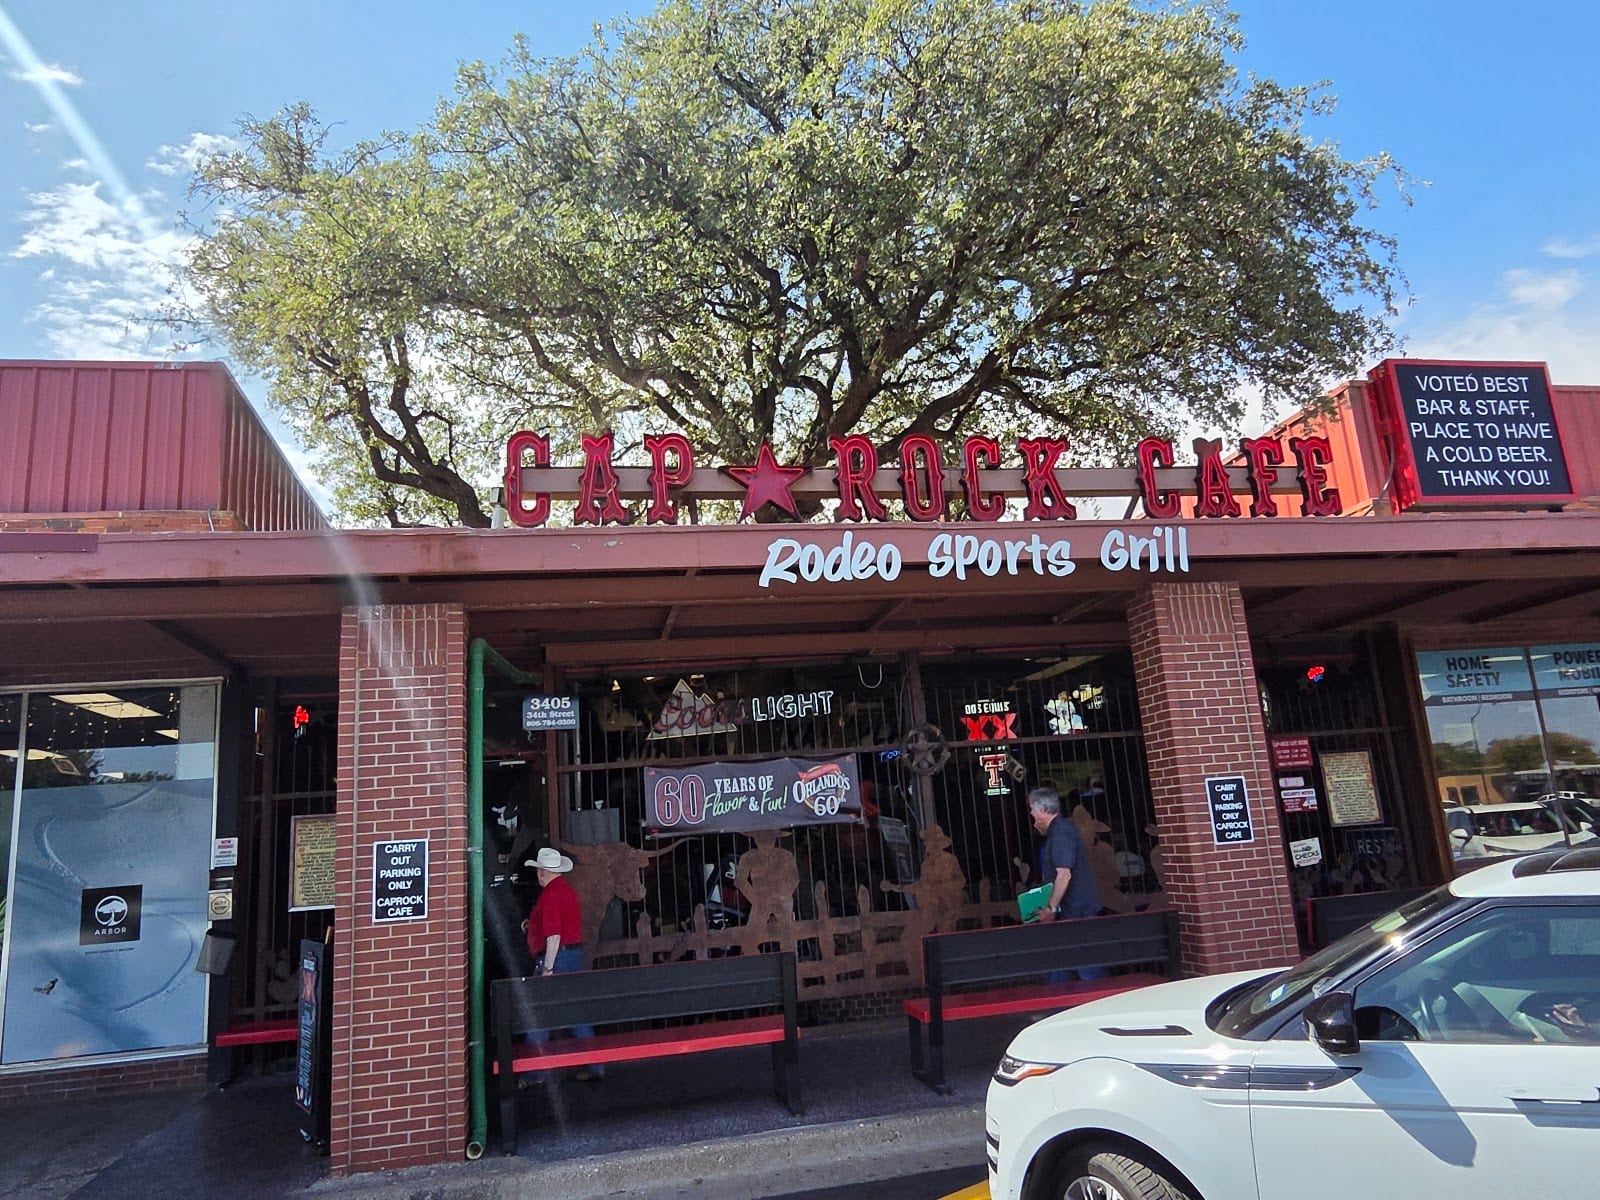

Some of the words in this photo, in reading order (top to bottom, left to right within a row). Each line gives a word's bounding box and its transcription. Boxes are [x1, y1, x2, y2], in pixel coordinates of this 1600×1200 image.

[1415, 373, 1479, 392] VOTED
[1483, 376, 1529, 392] BEST
[1416, 399, 1454, 415] BAR
[1459, 400, 1472, 415] &
[1476, 400, 1535, 417] STAFF,
[1410, 423, 1471, 438] PLACE
[1474, 423, 1500, 438] TO
[1504, 423, 1552, 439] HAVE
[1426, 447, 1440, 462] A
[1442, 447, 1493, 462] COLD
[1497, 447, 1553, 462] BEER.
[504, 430, 695, 527] CAP
[828, 432, 1078, 523] ROCK
[1135, 434, 1343, 519] CAFE
[1437, 470, 1502, 486] THANK
[1504, 470, 1551, 485] YOU!
[758, 531, 902, 588] Rodeo
[927, 532, 1076, 581] Sports
[1100, 526, 1190, 573] Grill
[1446, 656, 1491, 671] HOME
[1446, 672, 1500, 688] SAFETY
[530, 696, 571, 710] 3405
[752, 690, 834, 722] LIGHT
[965, 703, 983, 715] DOS
[983, 701, 1010, 713] EQUIS
[526, 711, 547, 719] 34th
[549, 710, 575, 718] Street
[960, 713, 1018, 741] XX
[714, 776, 756, 793] YEARS
[758, 775, 774, 791] OF
[793, 773, 851, 803] ORLANDO'S
[1214, 783, 1237, 792] CARRY
[655, 775, 706, 826] 60
[701, 791, 748, 820] Flavor
[748, 796, 760, 811] &
[760, 785, 788, 815] Fun!
[1220, 793, 1234, 801] OUT
[1214, 802, 1244, 811] PARKING
[1221, 812, 1239, 820] ONLY
[1215, 821, 1248, 830] CAPROCK
[1225, 831, 1242, 839] CAFE
[384, 843, 417, 854] CARRY
[1357, 839, 1387, 854] RES
[390, 856, 411, 865] OUT
[380, 867, 421, 879] PARKING
[388, 880, 413, 891] ONLY
[377, 895, 423, 907] CAPROCK
[387, 906, 413, 917] CAFE
[94, 926, 127, 936] ARBOR
